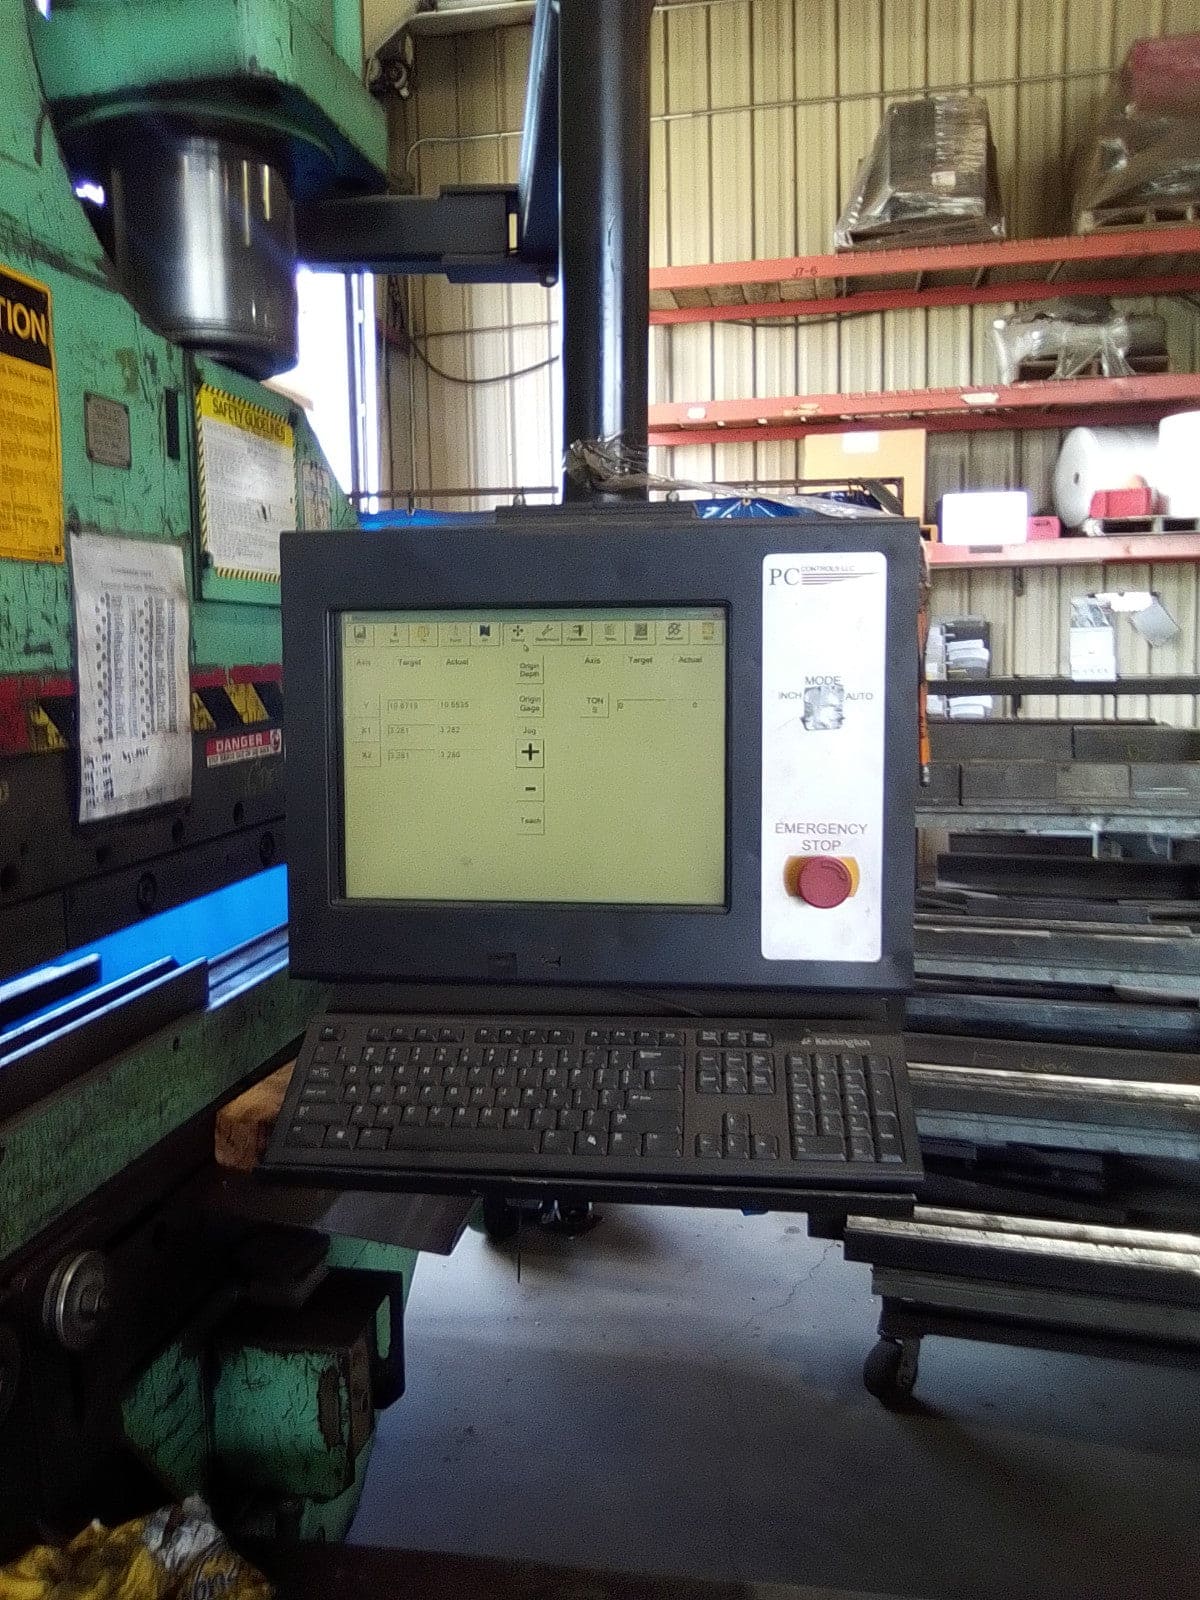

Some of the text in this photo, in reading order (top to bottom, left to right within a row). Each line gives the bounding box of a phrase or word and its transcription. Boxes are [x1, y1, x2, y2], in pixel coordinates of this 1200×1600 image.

[212, 397, 243, 424] SAFETY
[769, 567, 800, 586] PC
[399, 658, 421, 667] Target
[446, 658, 469, 666] Actual
[584, 655, 703, 665] Axis Target Actual
[805, 675, 841, 685] MODE
[778, 691, 874, 700] INCH AUTO
[215, 733, 263, 753] DANGER
[775, 822, 868, 834] EMERGENCY
[801, 839, 842, 851] STOP
